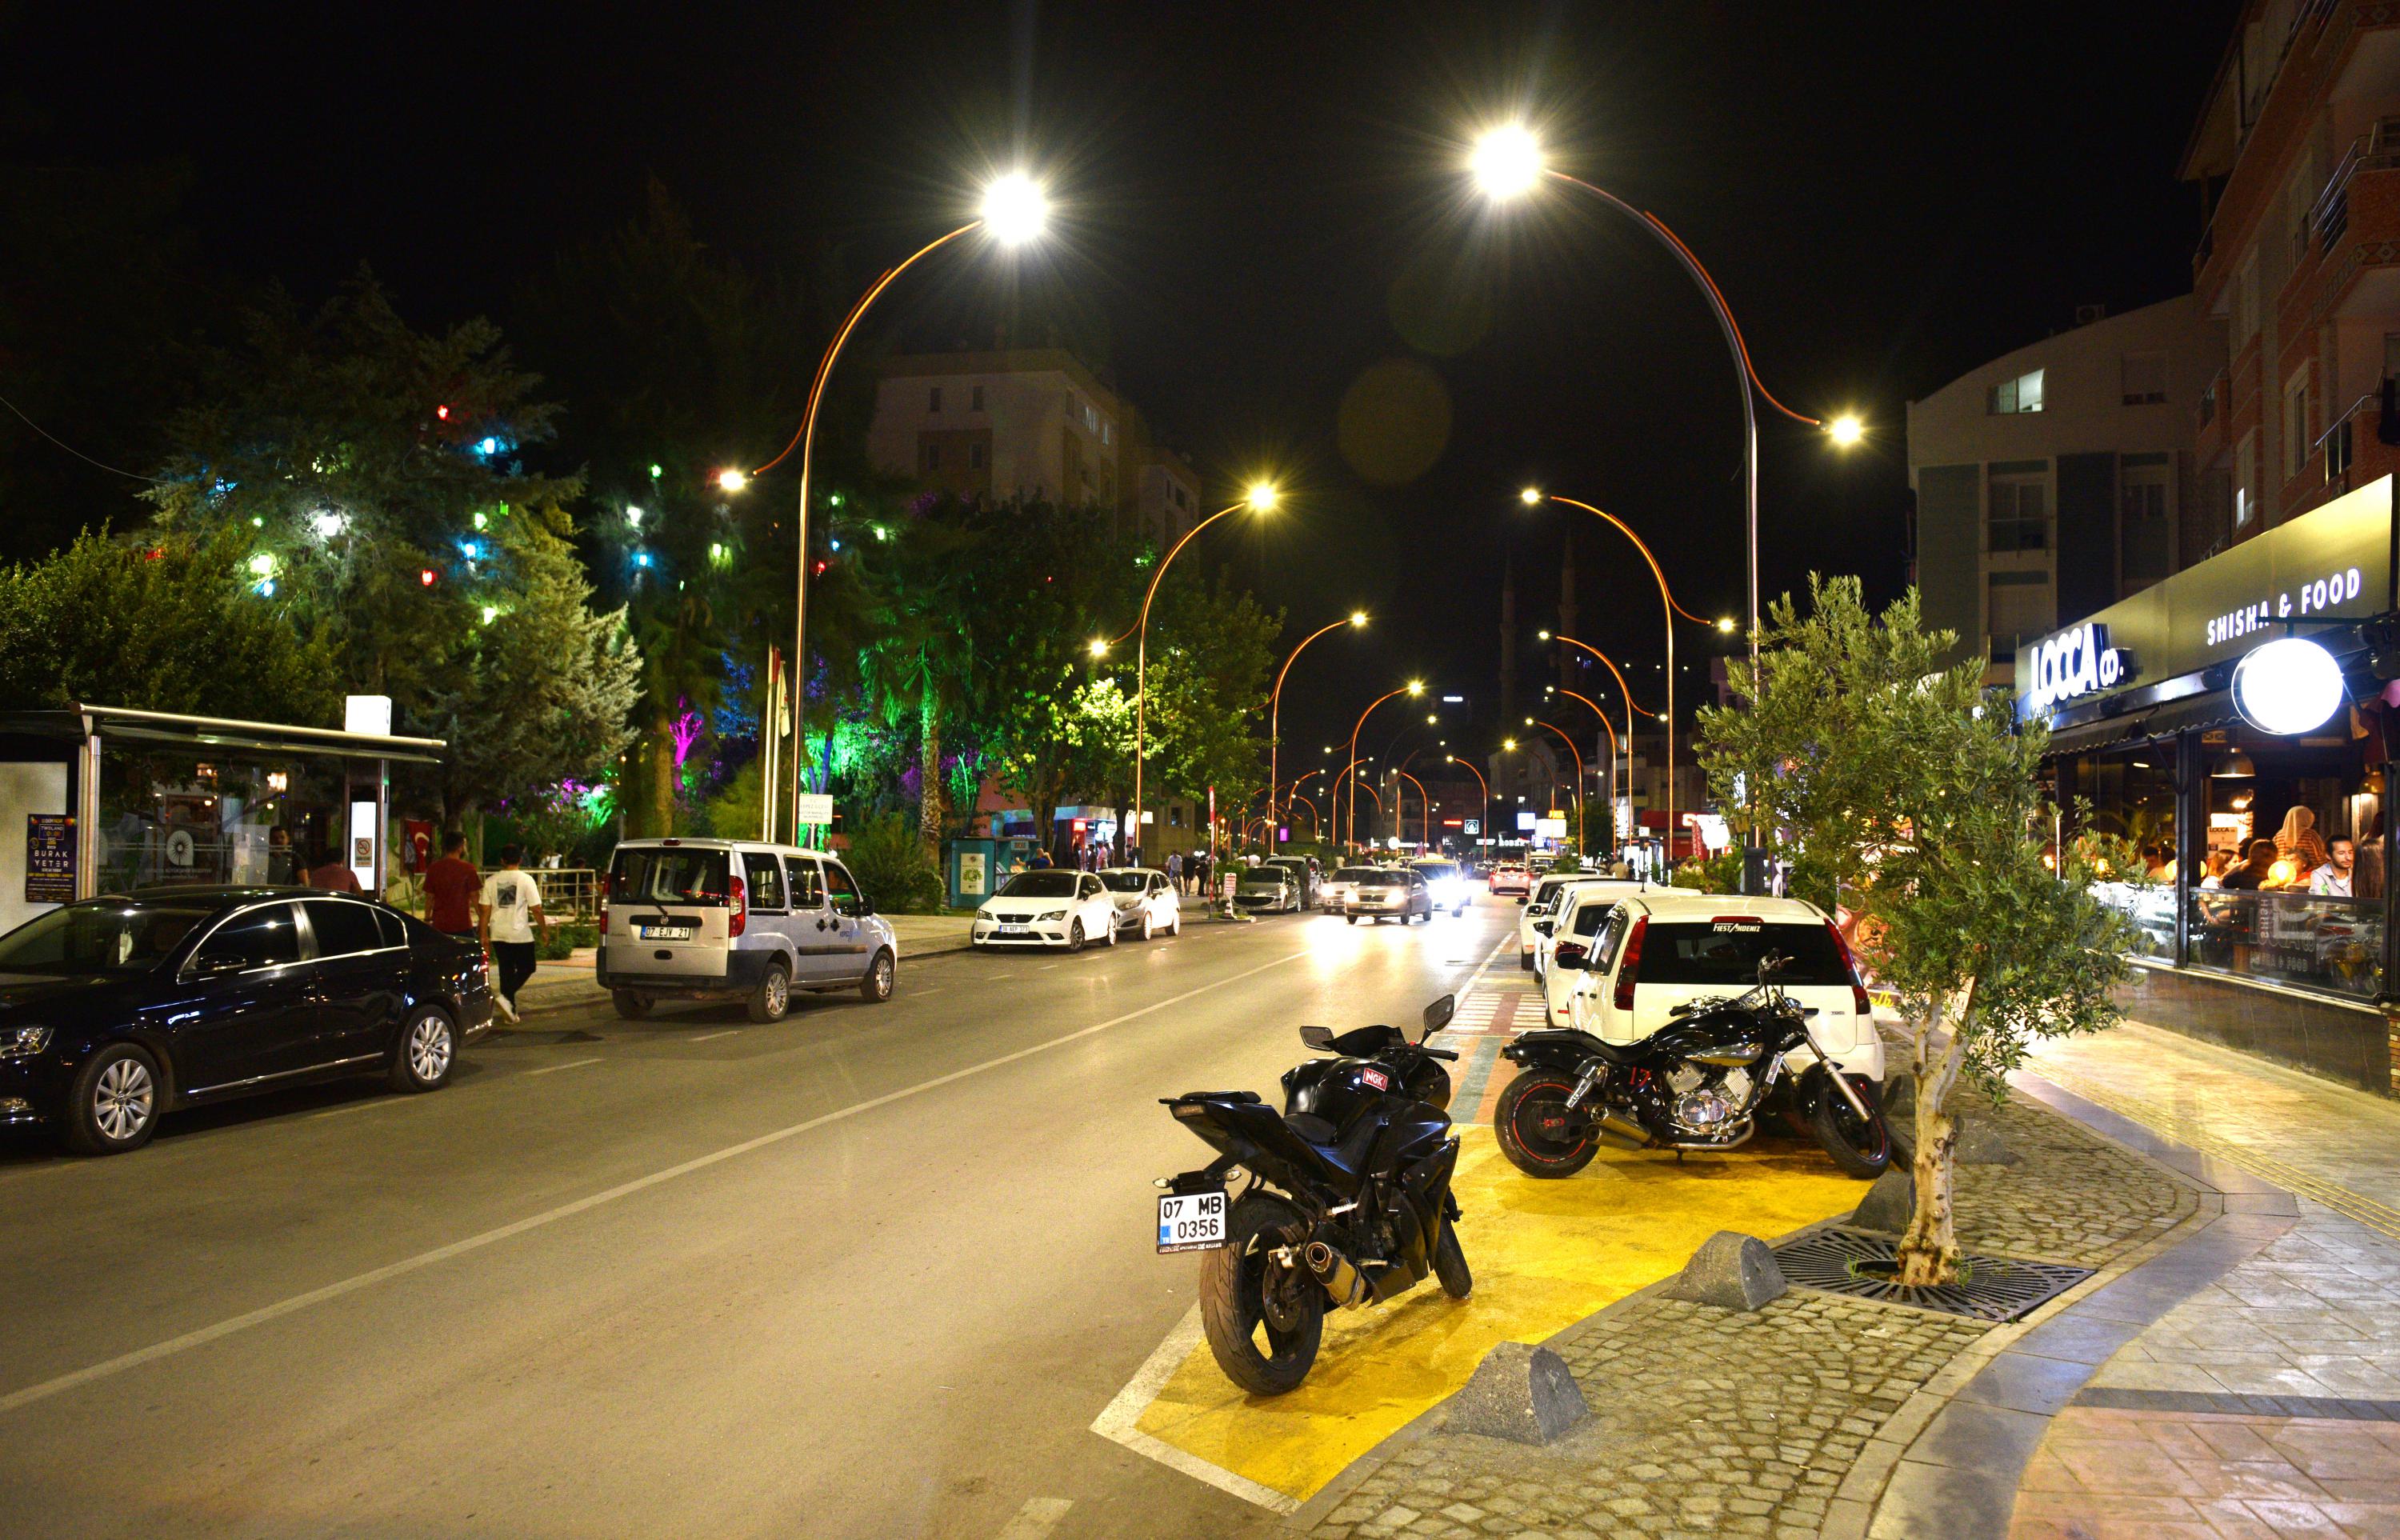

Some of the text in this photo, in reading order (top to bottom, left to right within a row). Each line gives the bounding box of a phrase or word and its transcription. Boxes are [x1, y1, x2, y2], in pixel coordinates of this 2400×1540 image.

[2207, 569, 2360, 646] SHISHA & FOOD
[2031, 622, 2098, 707] LOCCA
[34, 860, 69, 868] YETER
[646, 927, 688, 938] 07 EJV 21
[1164, 1196, 1222, 1218] 07 MB
[1178, 1218, 1218, 1238] 0356
